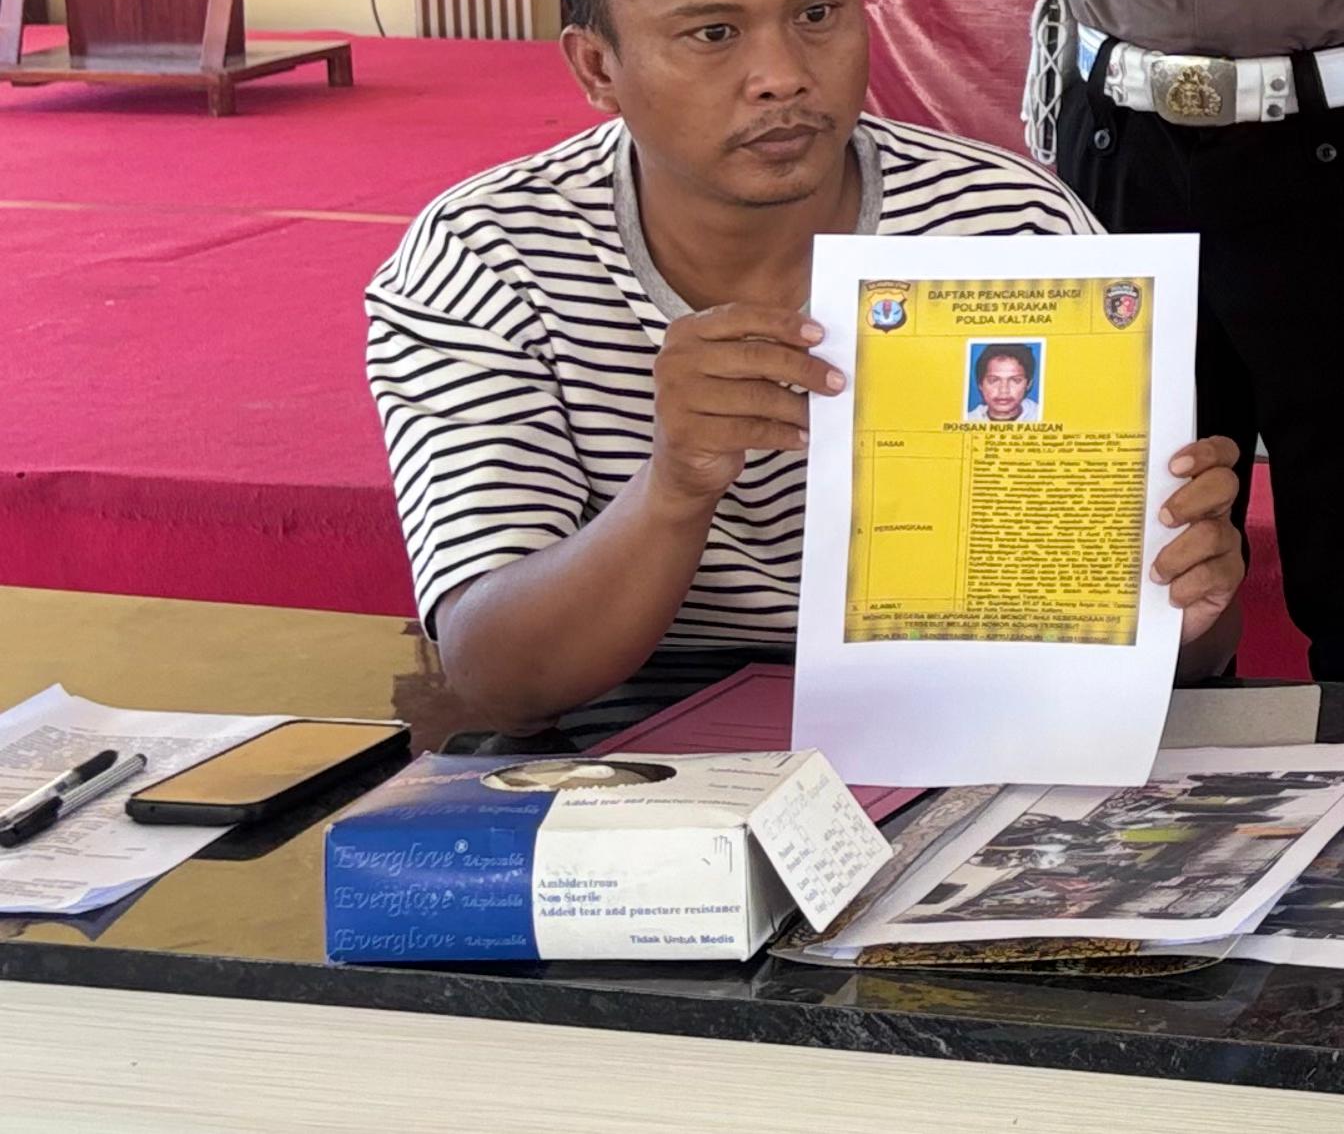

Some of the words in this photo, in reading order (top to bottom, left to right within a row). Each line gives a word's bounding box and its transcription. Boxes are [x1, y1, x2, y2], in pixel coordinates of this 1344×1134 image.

[952, 302, 998, 312] POLRES
[1001, 302, 1057, 312] TARAKAN
[956, 314, 995, 324] POLDA
[990, 422, 1014, 432] NUR
[539, 907, 576, 917] Added
[579, 907, 602, 916] tear
[629, 906, 681, 918] puncture
